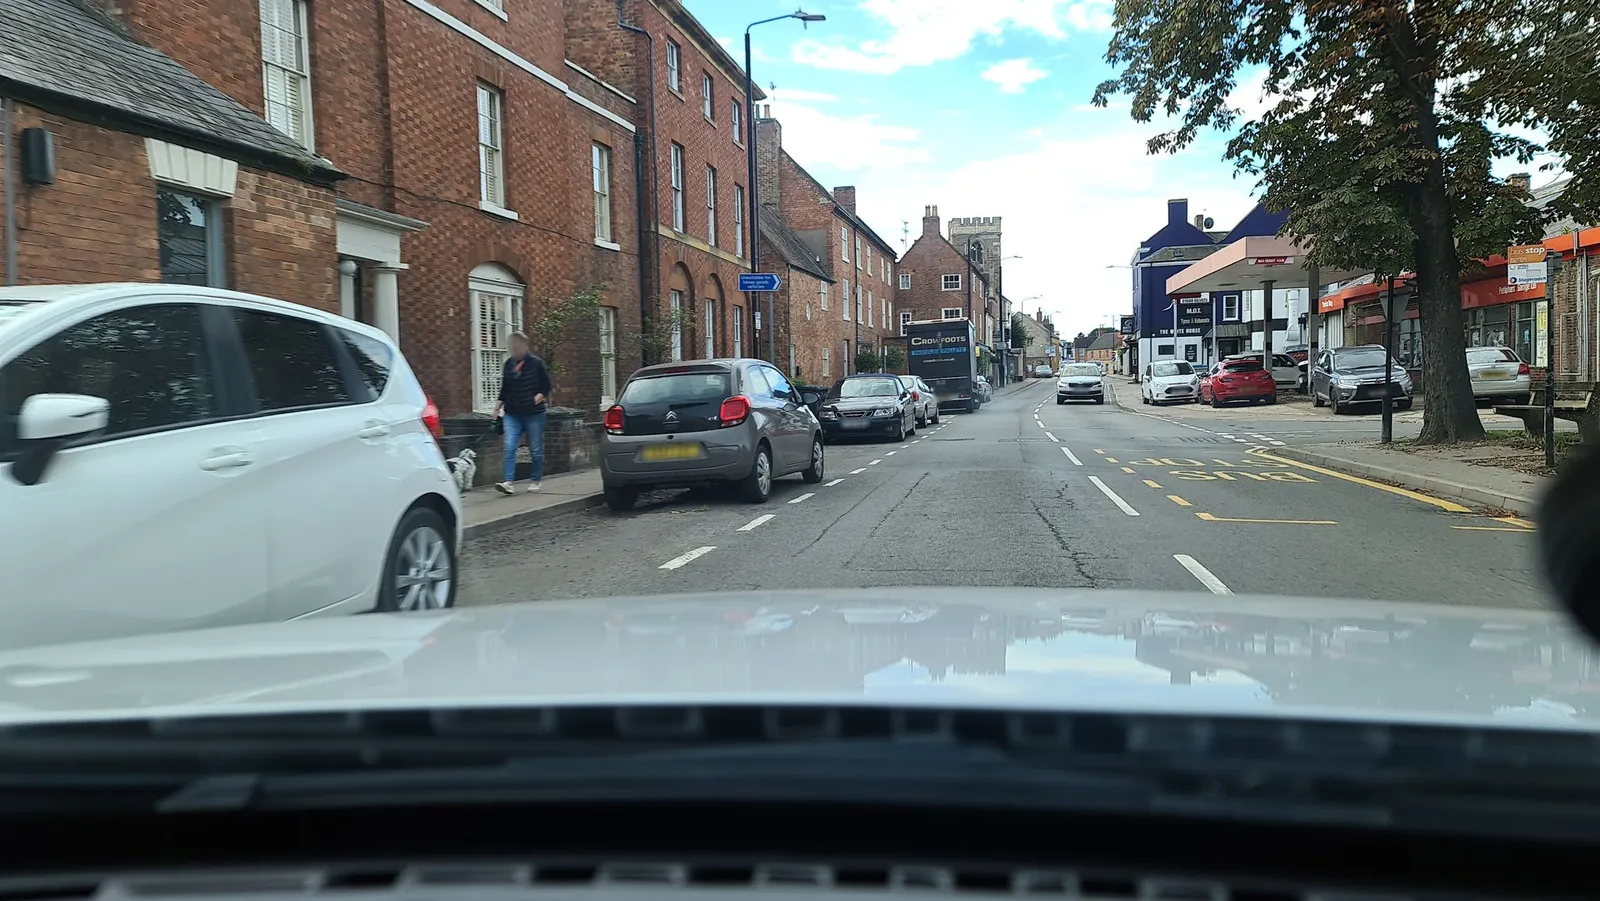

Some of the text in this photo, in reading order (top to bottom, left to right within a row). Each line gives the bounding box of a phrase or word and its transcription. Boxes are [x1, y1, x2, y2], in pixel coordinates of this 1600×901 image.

[912, 336, 966, 346] CROWFOOTS
[1128, 457, 1290, 468] STOP
[1169, 470, 1319, 483] BUS
